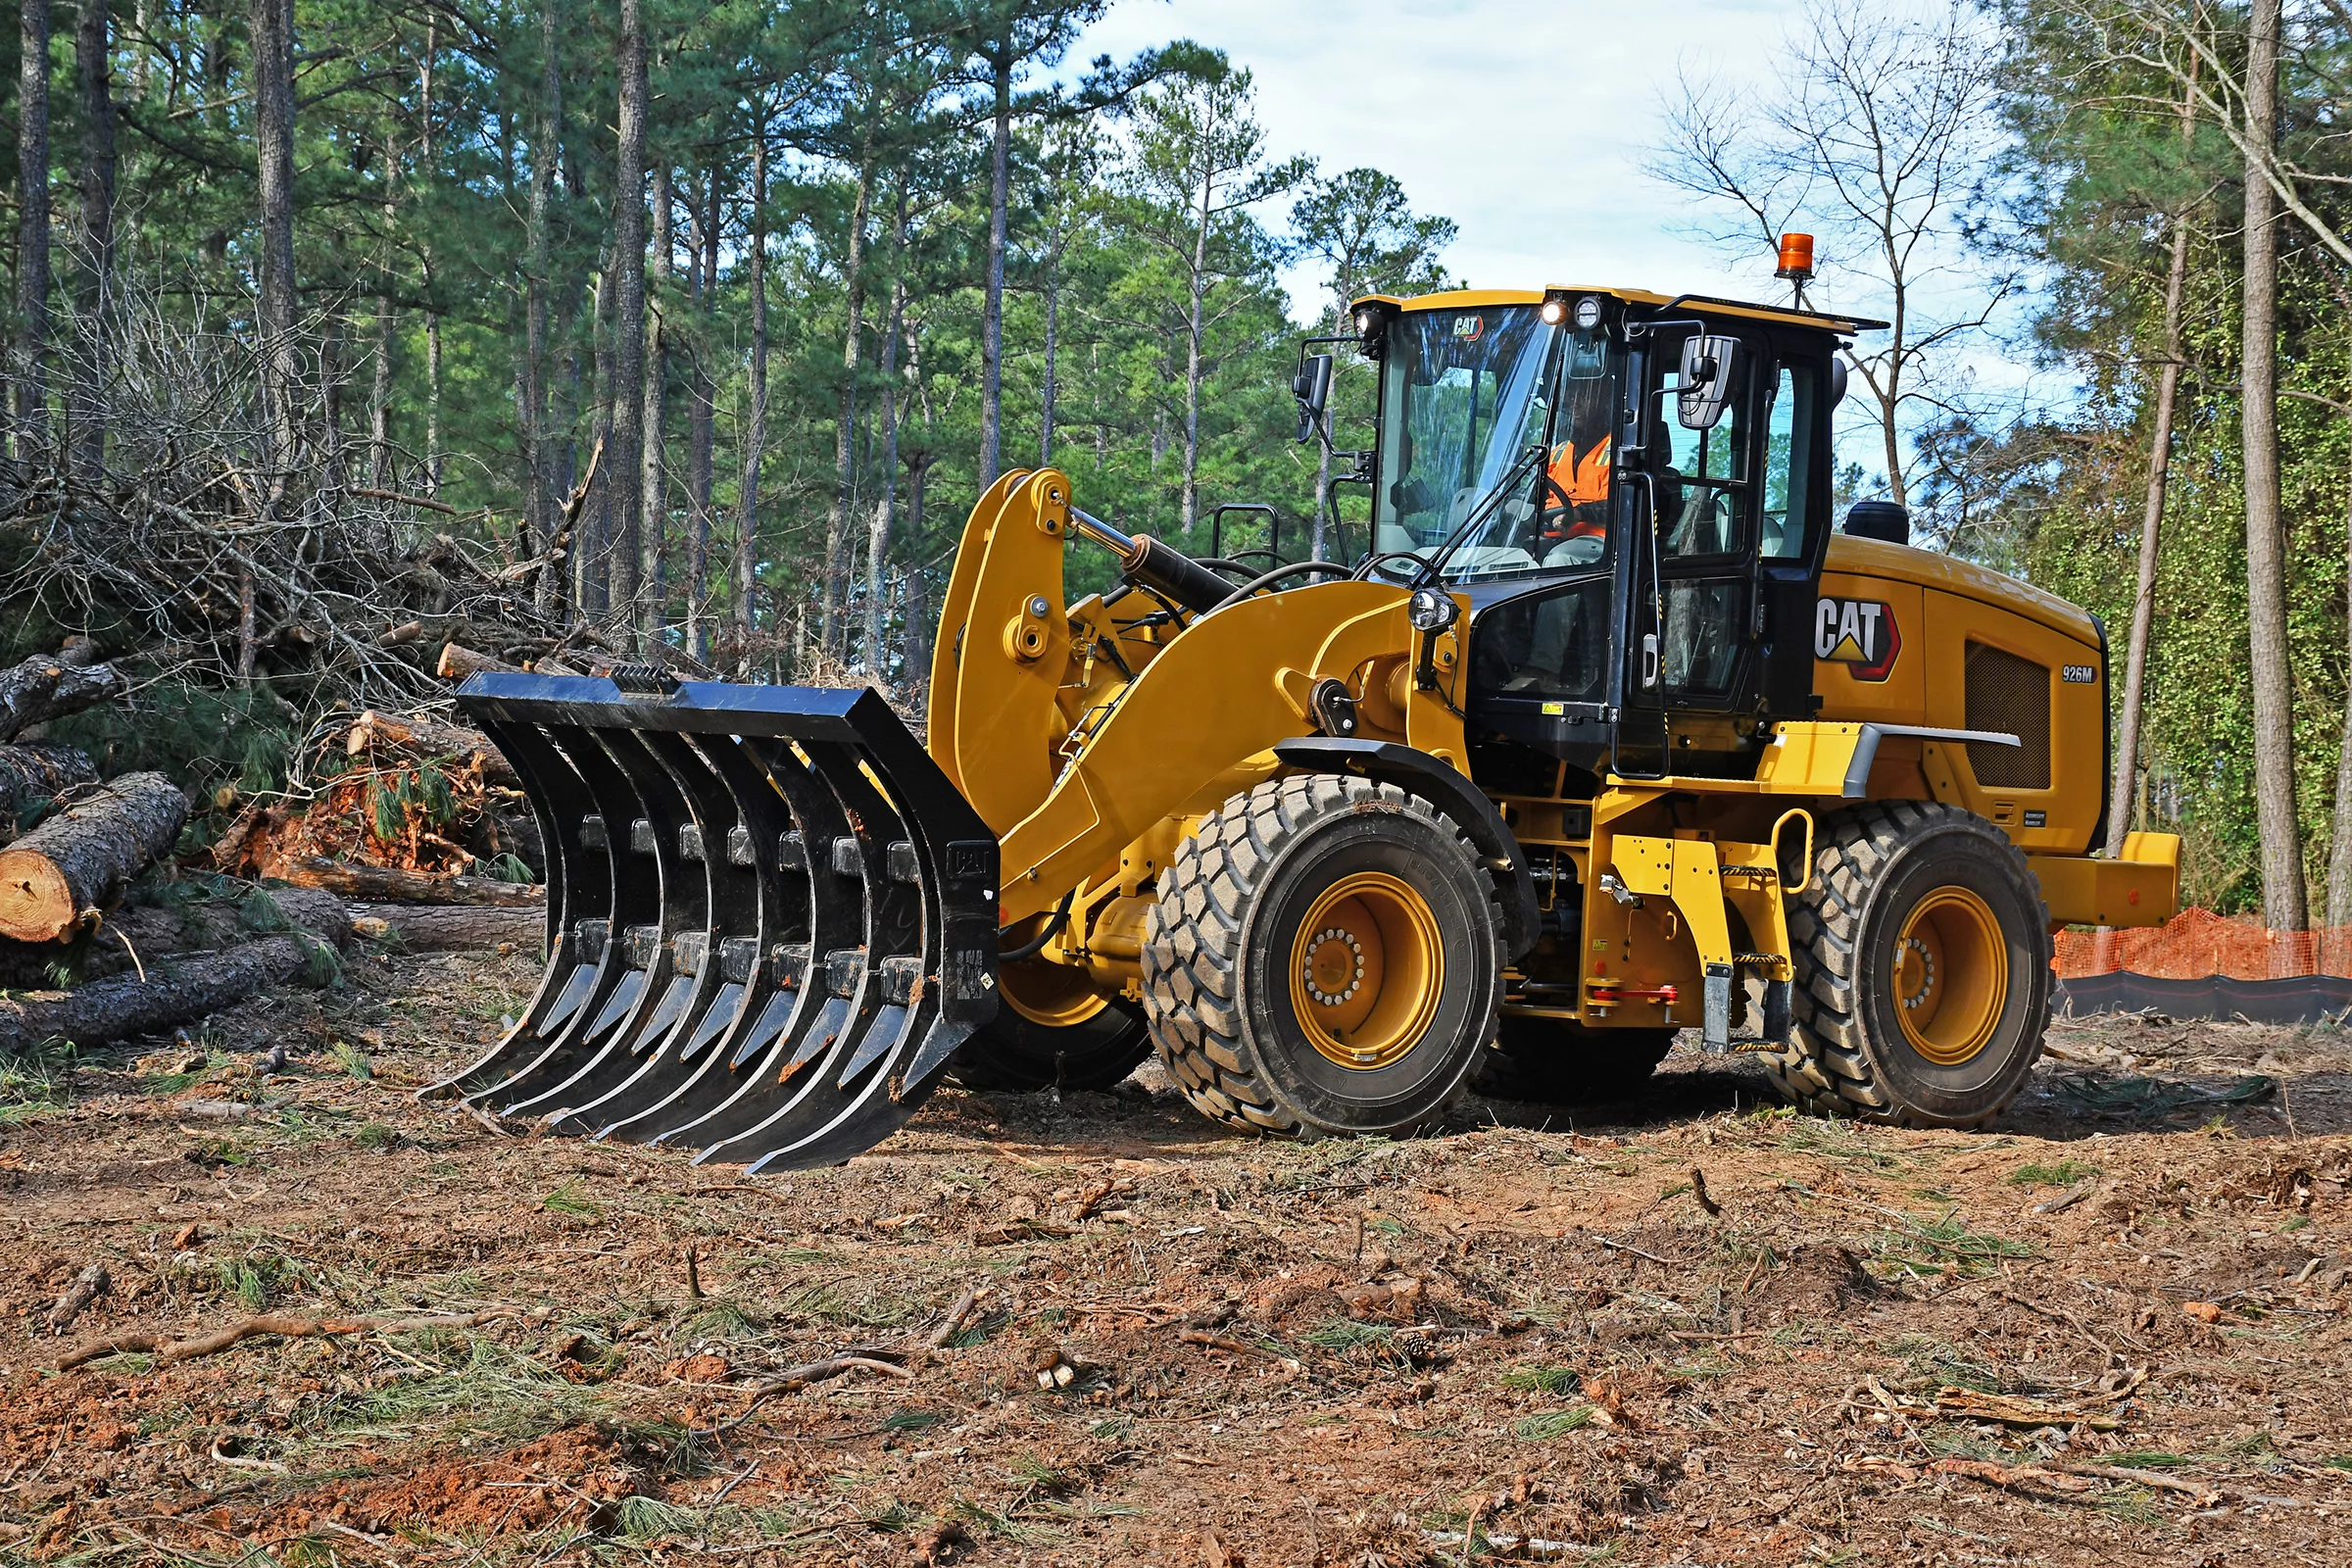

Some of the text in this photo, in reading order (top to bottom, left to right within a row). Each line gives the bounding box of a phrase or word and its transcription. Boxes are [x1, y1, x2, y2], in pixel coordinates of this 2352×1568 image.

[1453, 318, 1477, 335] CAT
[1815, 598, 1881, 662] CAT
[2063, 665, 2092, 682] 926M
[956, 850, 990, 874] CAT
